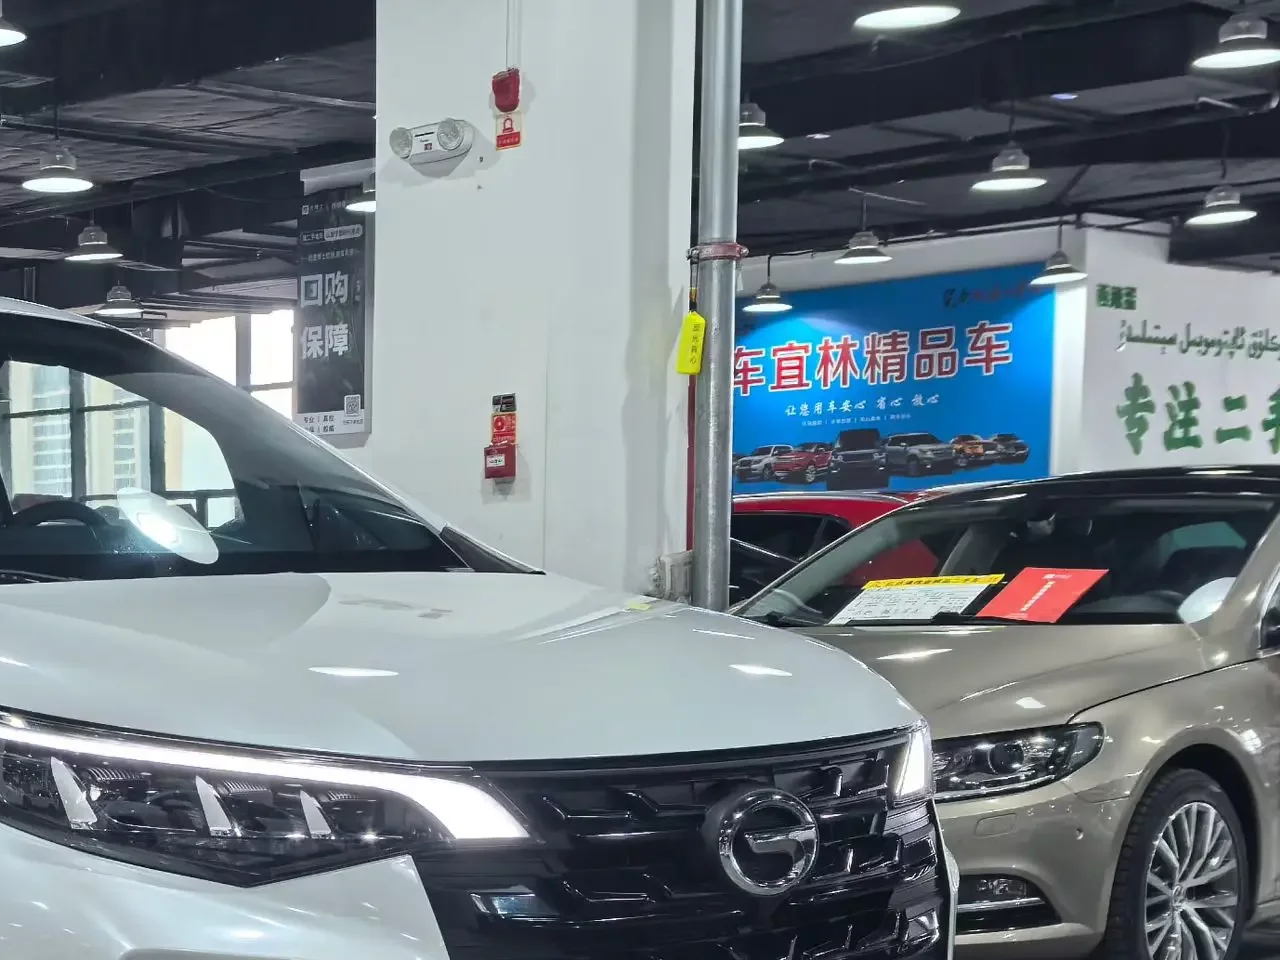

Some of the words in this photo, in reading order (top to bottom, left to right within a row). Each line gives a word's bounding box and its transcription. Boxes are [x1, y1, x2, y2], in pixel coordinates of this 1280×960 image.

[300, 270, 349, 308] 回购
[300, 322, 349, 361] 保障
[733, 320, 1013, 396] 车宜林精品车
